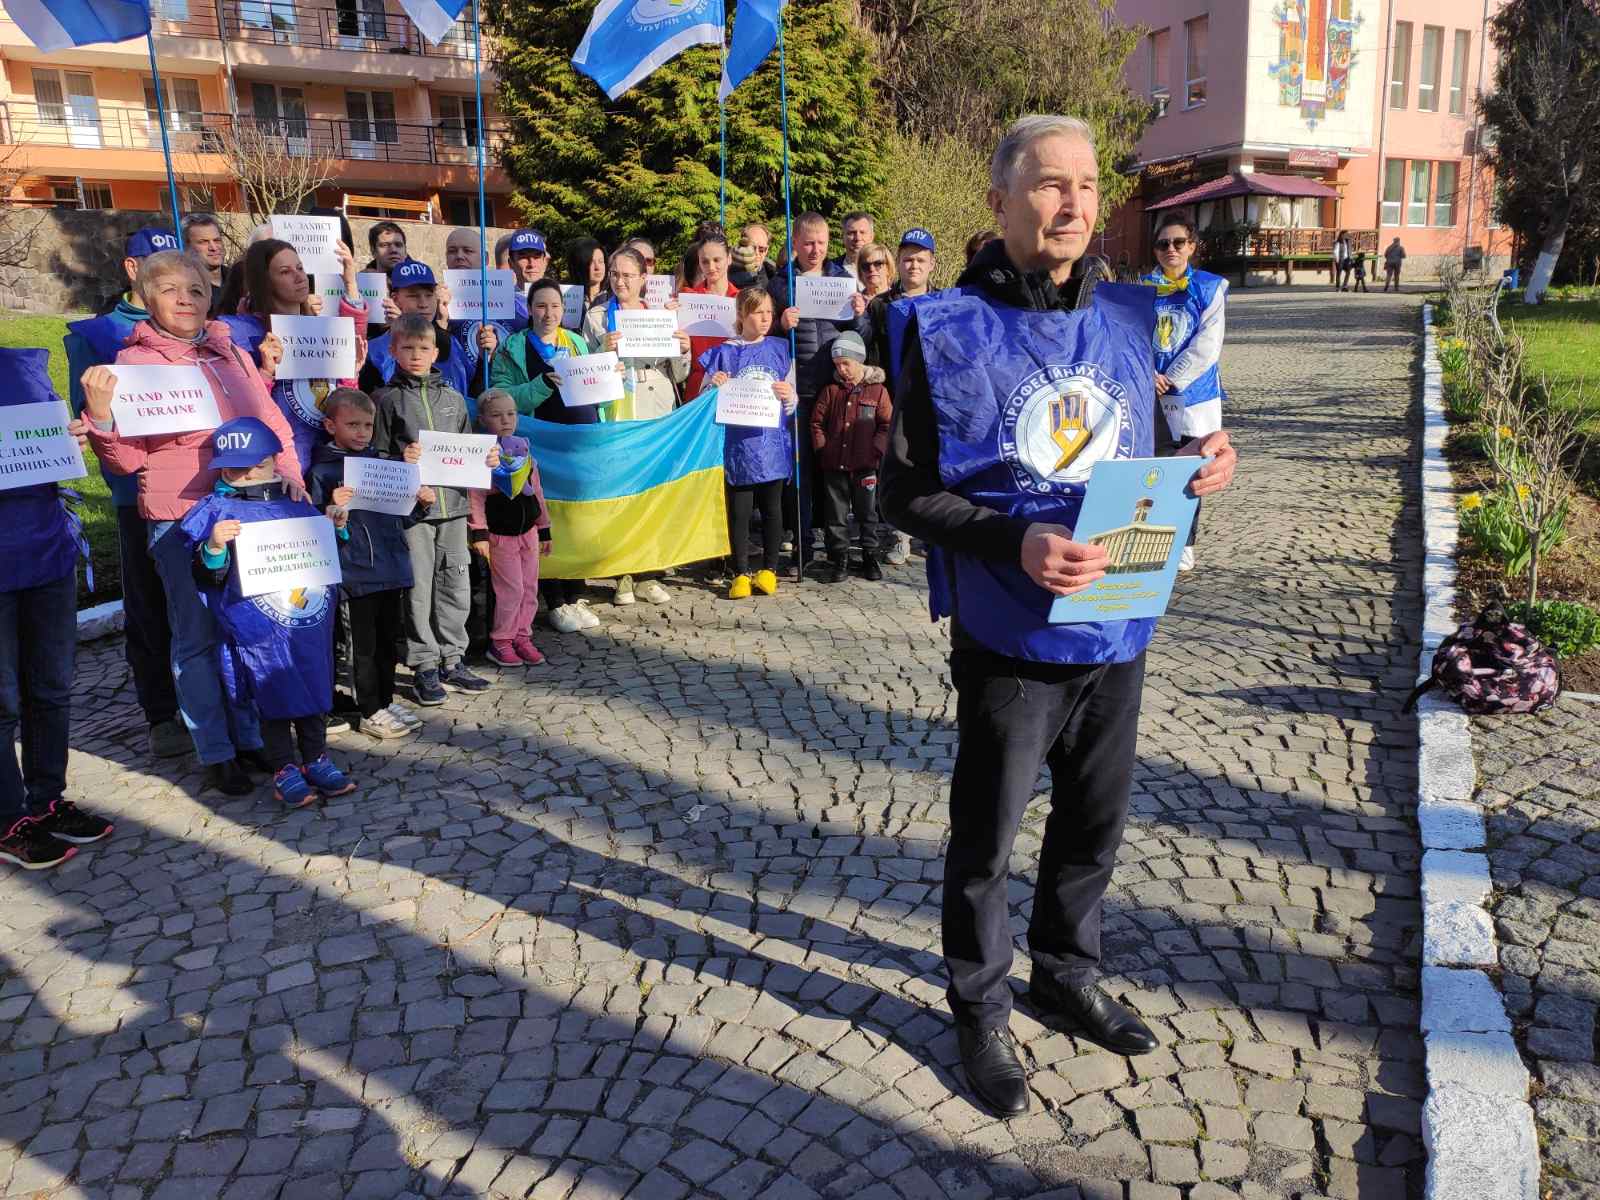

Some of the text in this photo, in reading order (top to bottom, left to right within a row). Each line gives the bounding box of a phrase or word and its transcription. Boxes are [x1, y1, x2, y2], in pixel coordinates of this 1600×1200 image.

[151, 234, 178, 248] ФП
[516, 233, 540, 244] ФПУ
[905, 229, 928, 241] ФПУ
[400, 263, 427, 277] ФПУ
[282, 336, 348, 346] STAND WITH
[292, 348, 338, 359] UKRAINE
[119, 388, 204, 402] STAND WITH
[1003, 365, 1097, 427] ПРОФЕСІЙНИХ
[137, 405, 196, 417] UKRAINE
[14, 426, 63, 440] ПРАЦЯ!
[216, 432, 252, 450] ФПУ
[431, 444, 483, 455] ДЯКУЄМО
[441, 457, 465, 466] CISL
[257, 539, 320, 553] ПРОФСПІЛКИ
